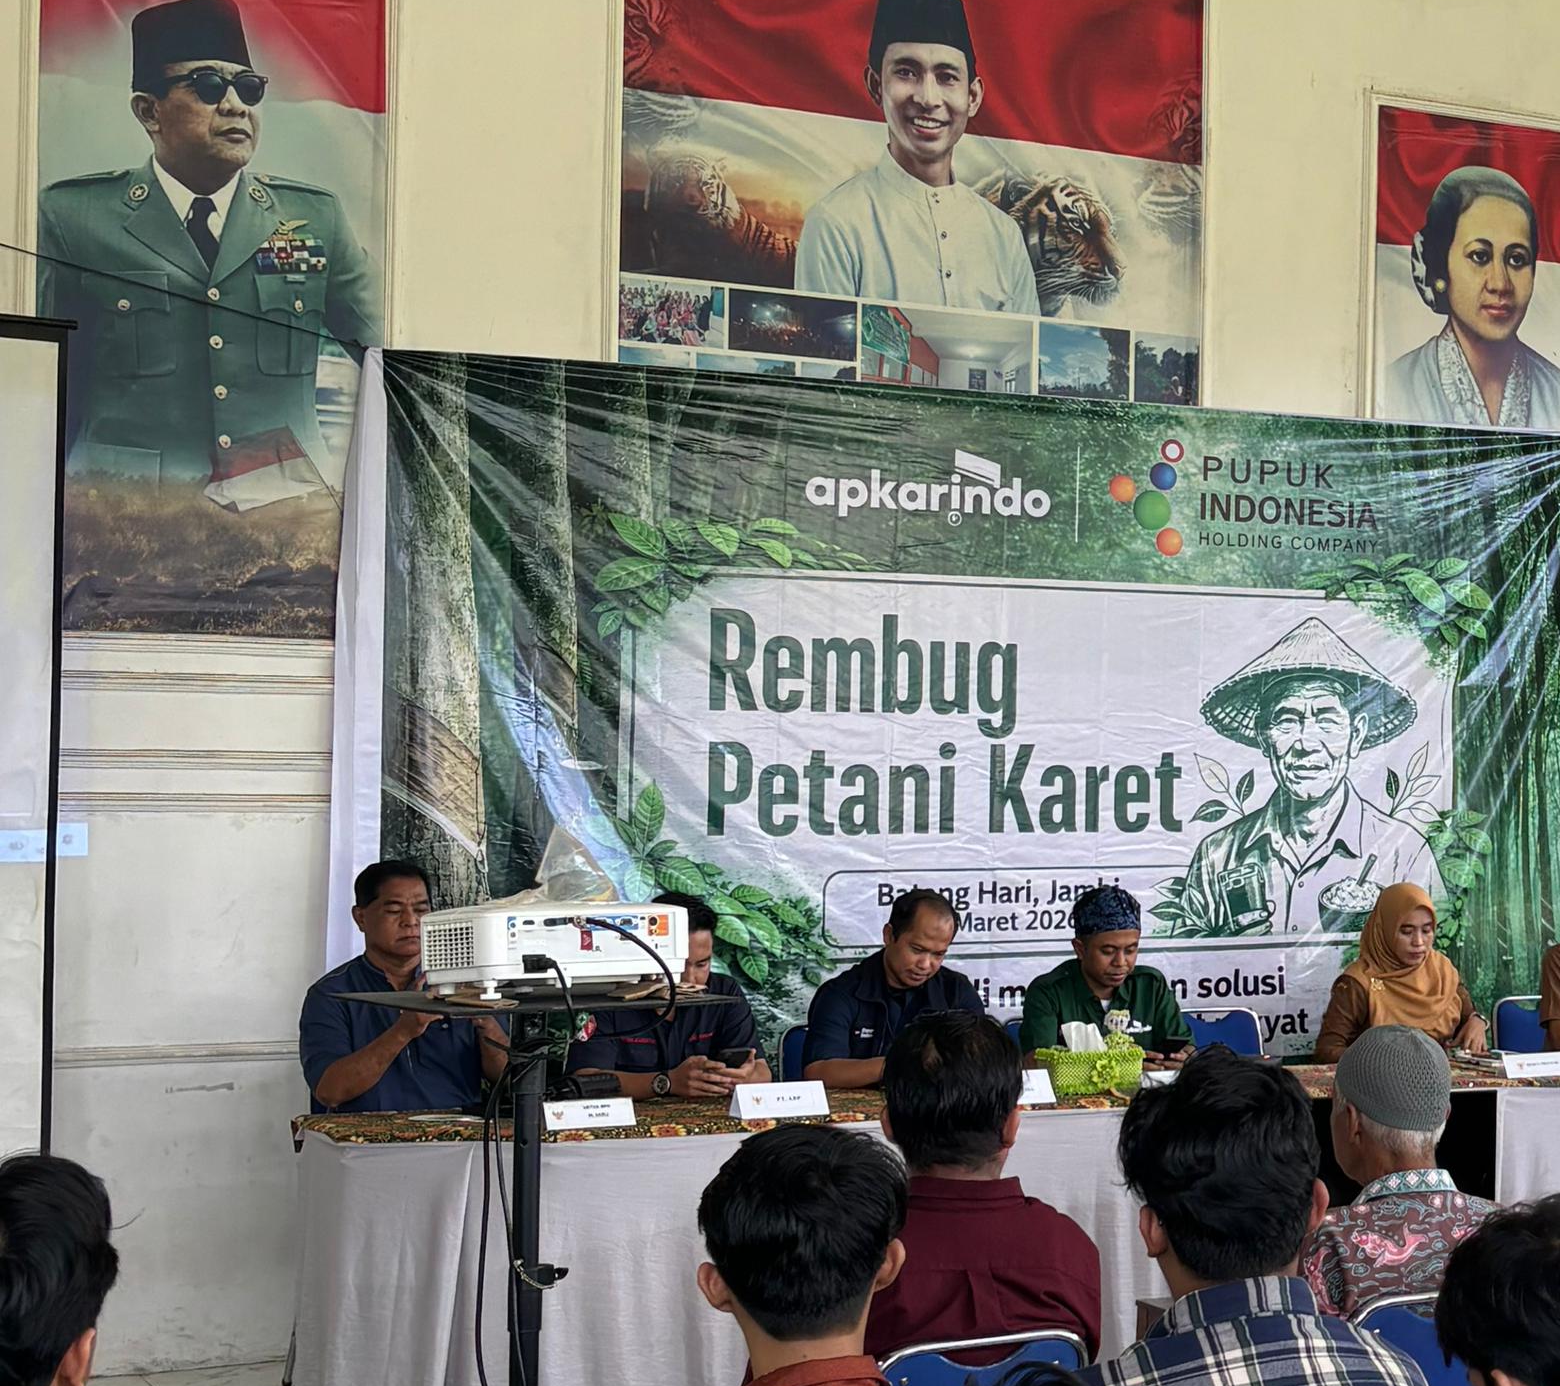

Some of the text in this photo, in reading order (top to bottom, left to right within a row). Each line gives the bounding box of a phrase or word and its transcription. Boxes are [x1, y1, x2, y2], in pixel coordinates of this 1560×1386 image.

[1202, 456, 1334, 490] PUPUK
[804, 468, 1051, 518] apkarindo
[1200, 492, 1378, 532] INDONESIA
[1199, 532, 1379, 553] HOLDING COMPANY
[708, 607, 1019, 739] Rembug
[706, 740, 1183, 837] Petani Karet
[877, 877, 1120, 911] Bng Hari, Jam
[957, 912, 1019, 933] Maret
[1196, 965, 1285, 999] solusi
[1258, 1008, 1309, 1043] yat
